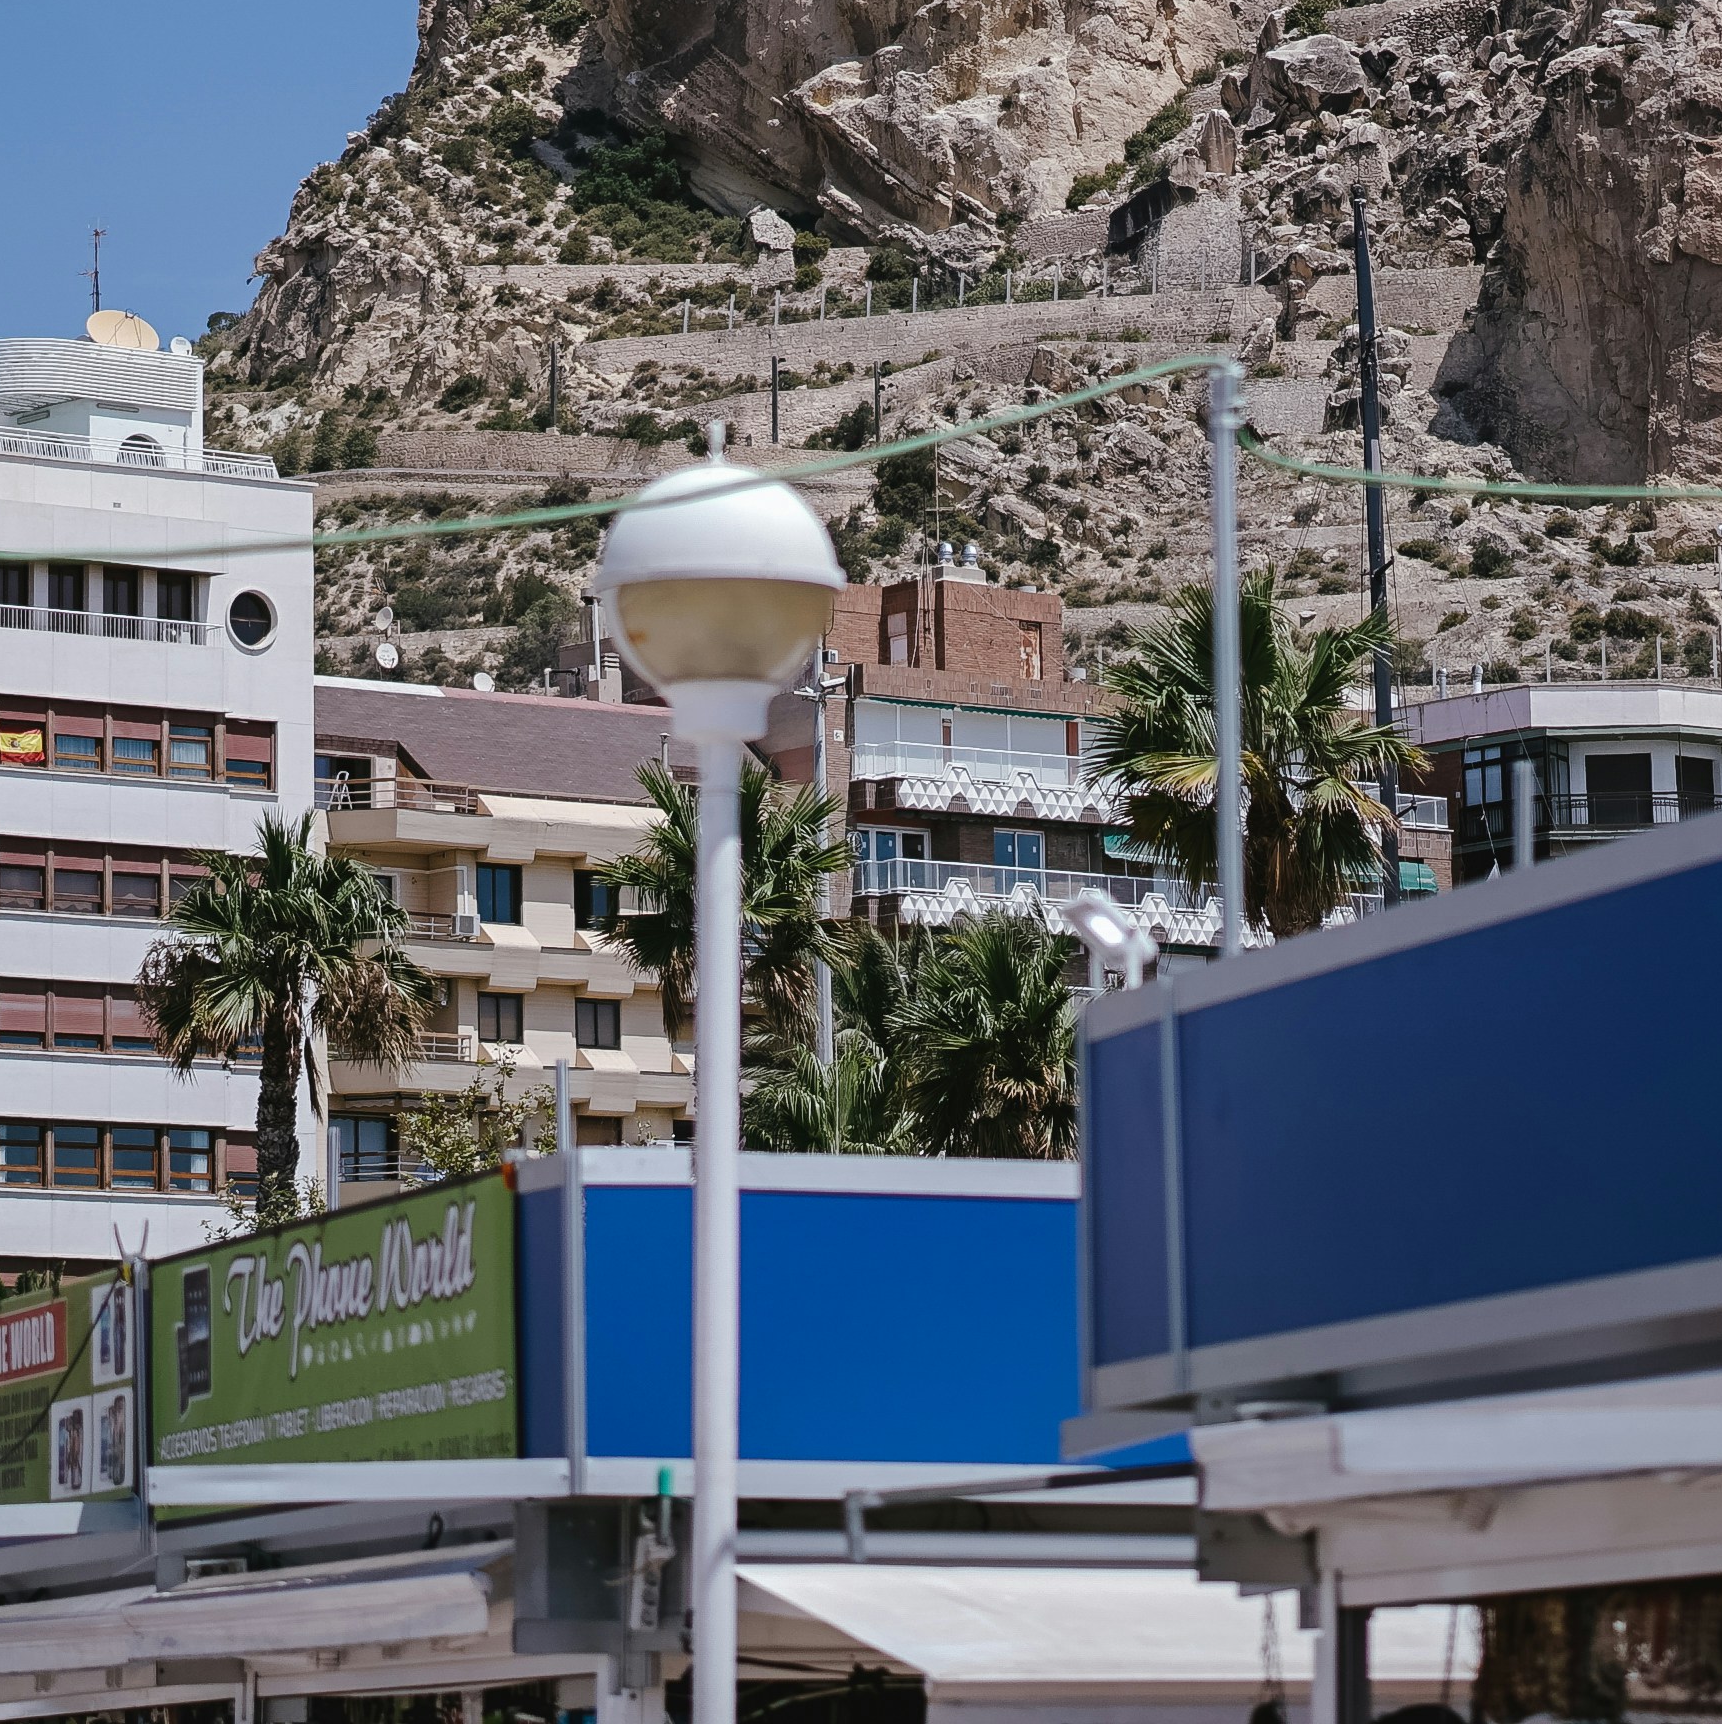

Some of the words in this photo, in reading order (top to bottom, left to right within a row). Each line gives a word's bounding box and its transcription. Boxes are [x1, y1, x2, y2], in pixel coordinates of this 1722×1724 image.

[223, 1254, 286, 1356] The
[286, 1238, 375, 1380] Phone
[377, 1197, 477, 1313] World
[10, 1311, 55, 1371] WORLD
[161, 1427, 217, 1460] ACCESORIOS
